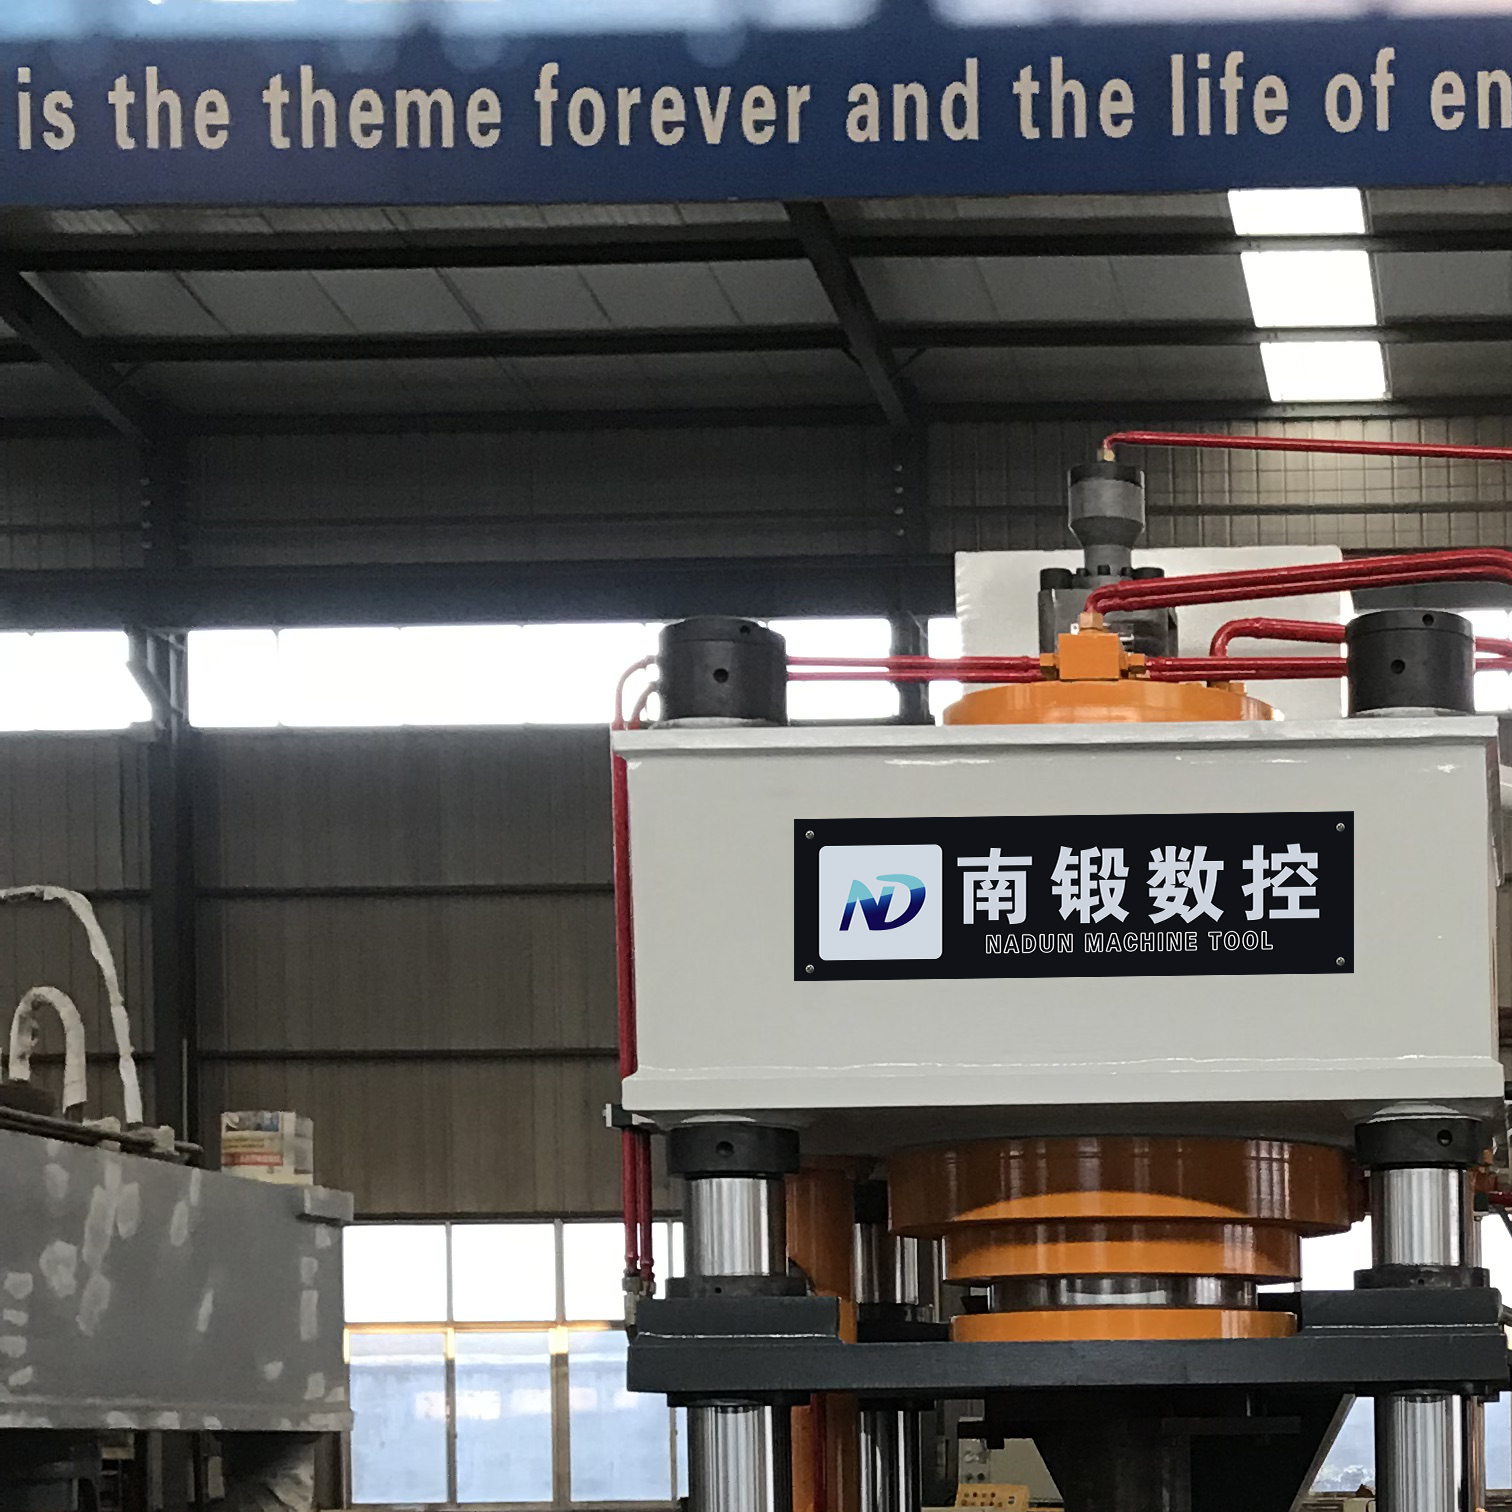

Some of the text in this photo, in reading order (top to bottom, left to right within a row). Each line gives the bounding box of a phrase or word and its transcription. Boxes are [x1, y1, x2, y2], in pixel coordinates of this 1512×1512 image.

[18, 67, 75, 150] is
[108, 66, 229, 150] the
[263, 65, 500, 149] theme
[535, 63, 810, 146] forever
[846, 58, 978, 142] and
[1013, 57, 1134, 139] the
[1171, 51, 1288, 135] life
[1325, 48, 1394, 132] of
[956, 843, 1321, 925] 南锻数控
[985, 930, 1274, 954] NADUN MACHINE TOOL
